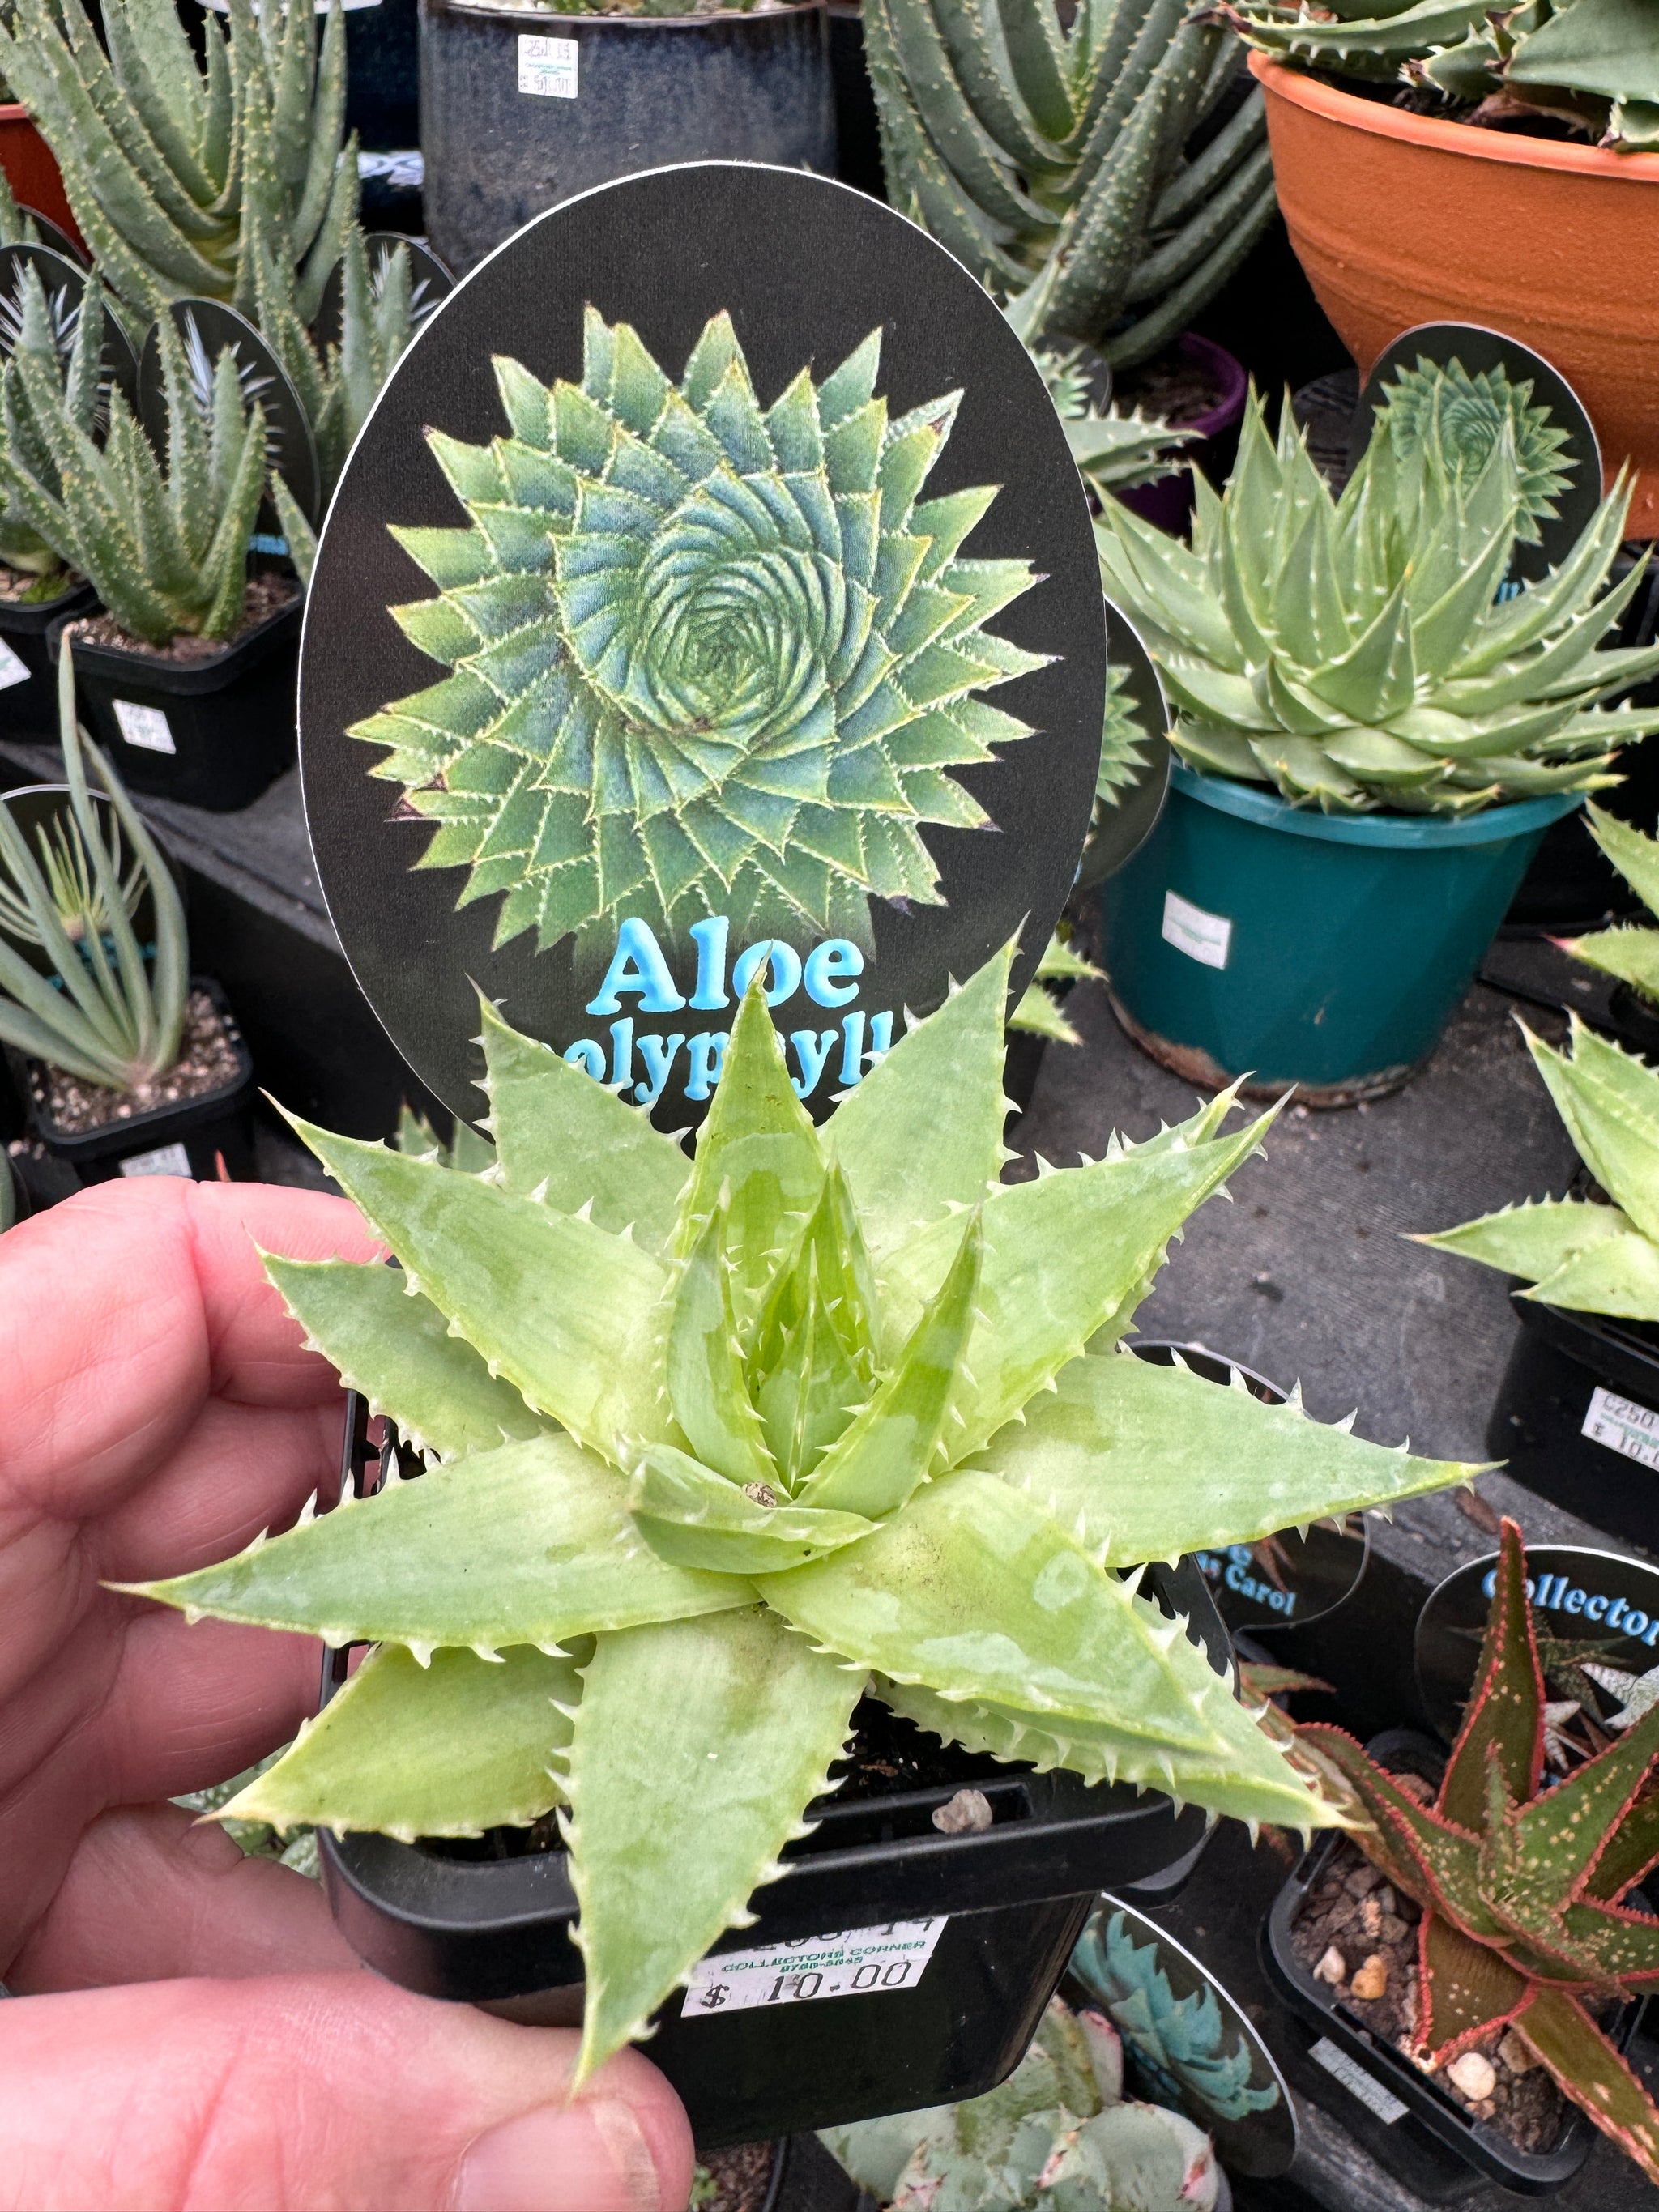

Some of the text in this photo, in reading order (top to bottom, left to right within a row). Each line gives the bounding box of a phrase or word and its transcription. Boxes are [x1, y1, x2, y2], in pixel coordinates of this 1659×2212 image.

[585, 915, 864, 1016] Aloe
[541, 1010, 894, 1103] olypyll
[1225, 1564, 1297, 1617] Carol
[700, 1984, 730, 2009] $
[767, 1961, 912, 2002] 10.00
